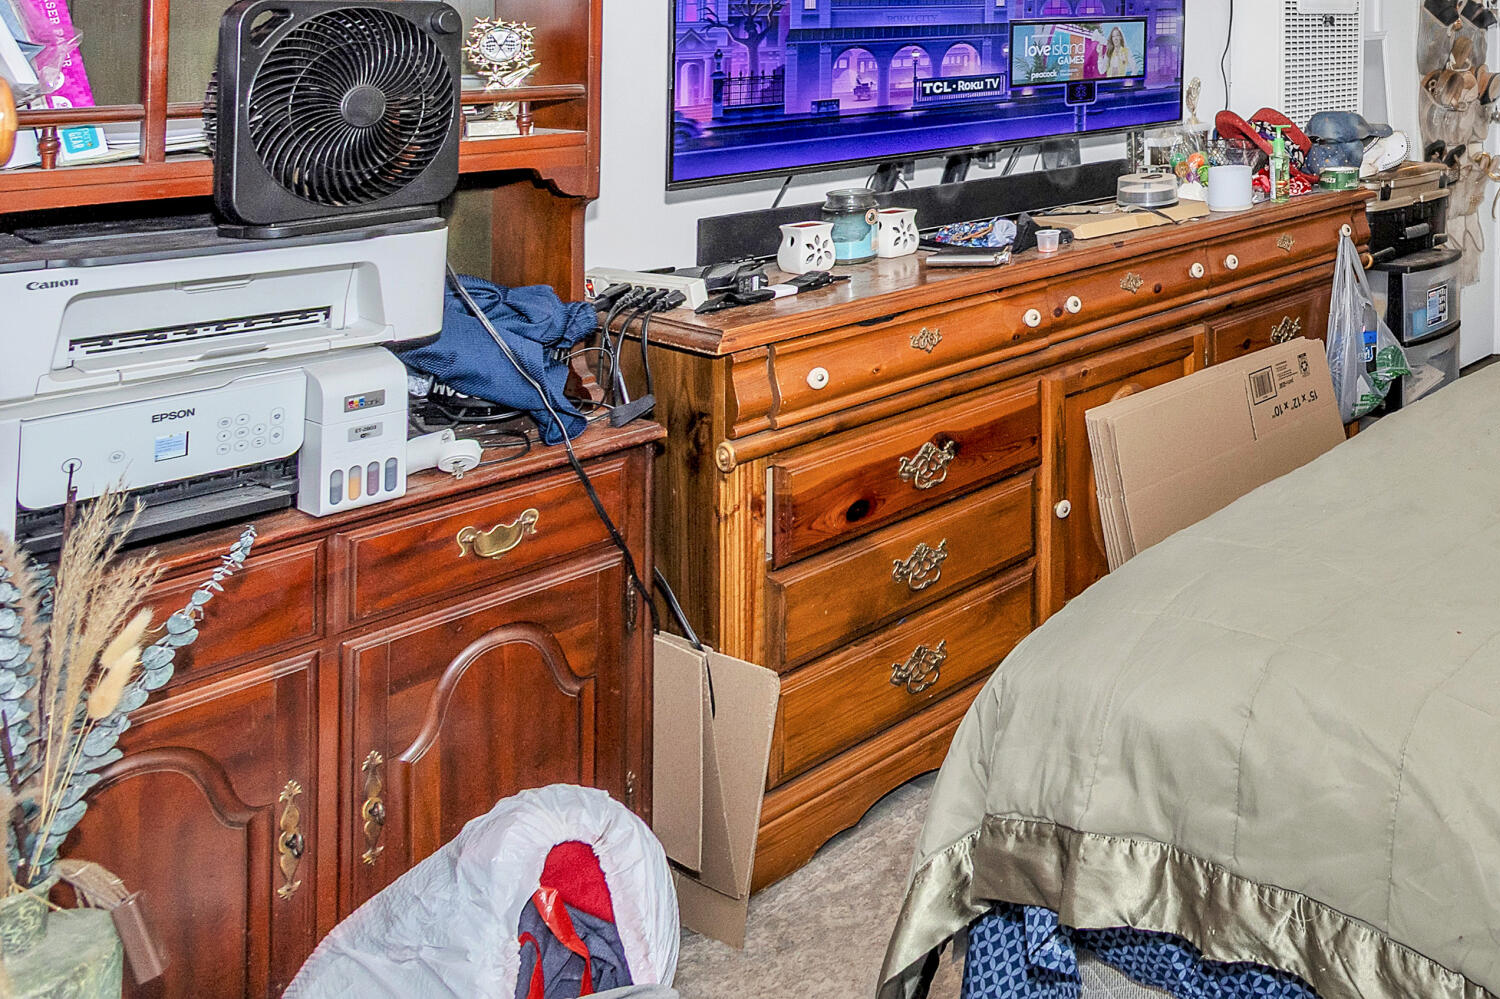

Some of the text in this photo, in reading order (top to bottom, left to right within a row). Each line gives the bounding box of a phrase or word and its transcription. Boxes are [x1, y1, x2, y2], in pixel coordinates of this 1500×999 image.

[52, 28, 73, 68] PAR
[1025, 34, 1085, 57] love island
[1057, 55, 1085, 66] GAMES
[1030, 69, 1058, 81] peacock
[923, 81, 952, 94] TCL
[985, 78, 1000, 89] TV
[26, 278, 79, 291] Canon
[1308, 389, 1319, 403] 15"
[1290, 397, 1302, 410] 12"
[151, 408, 196, 423] EPSON
